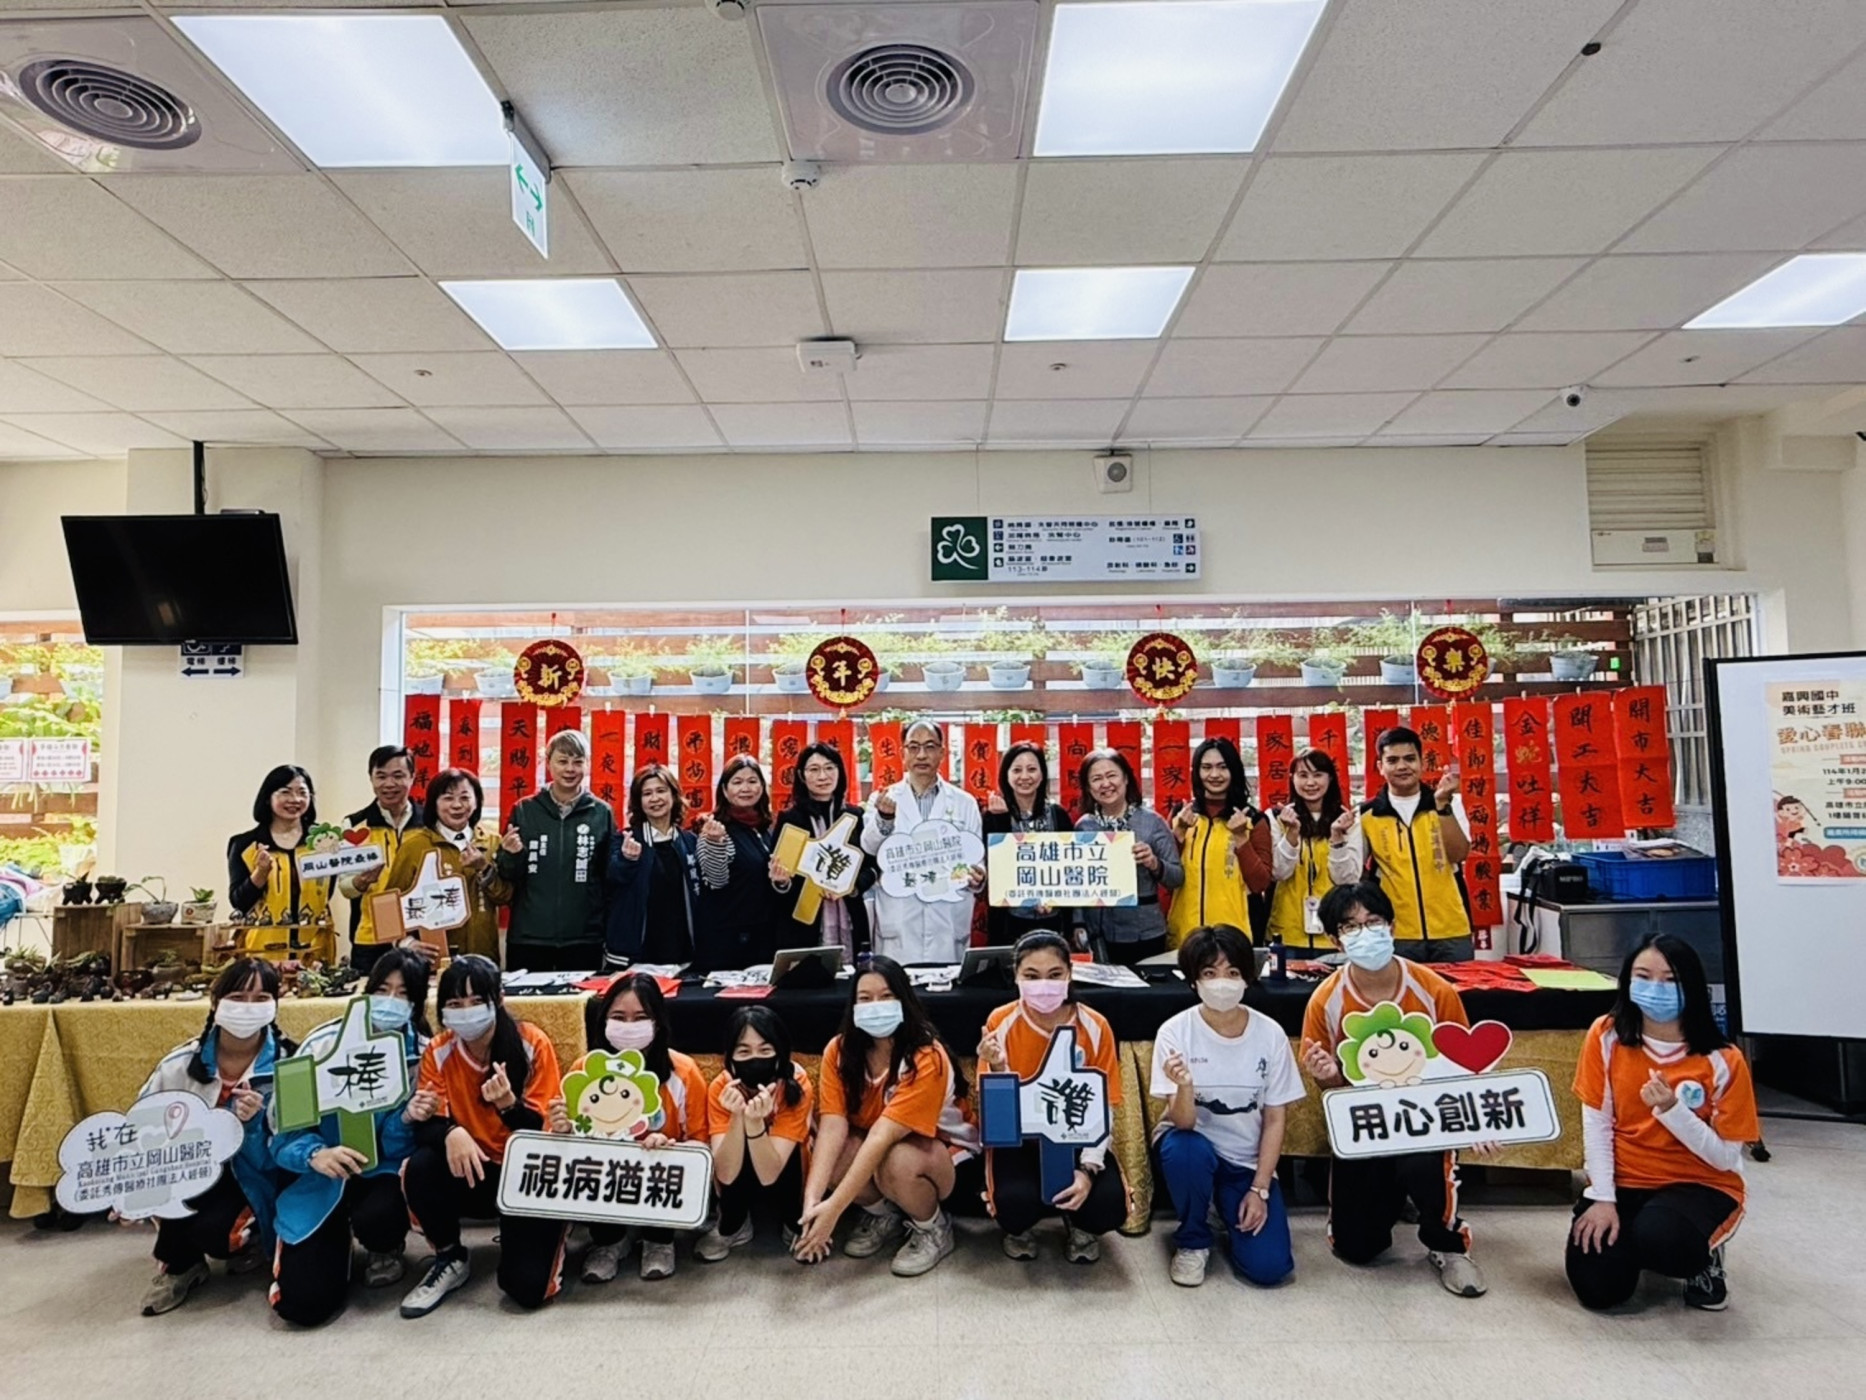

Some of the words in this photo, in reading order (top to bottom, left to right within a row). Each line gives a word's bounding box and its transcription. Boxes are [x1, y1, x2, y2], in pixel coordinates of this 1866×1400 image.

[538, 663, 563, 690] 新
[831, 660, 853, 687] 年
[1151, 656, 1176, 682] 快
[1511, 710, 1546, 831] 金蛇吐祥
[1570, 703, 1604, 829] 開工大吉
[1629, 697, 1658, 817] 開市大吉
[1016, 841, 1108, 862] 高雄市立
[1016, 865, 1109, 887] 岡山醫院
[327, 1045, 390, 1099] 棒
[1037, 1077, 1096, 1133] 讚
[1349, 1086, 1526, 1142] 用心創新
[77, 1140, 213, 1181] 高雄市立岡山醫院
[86, 1122, 139, 1152] 我在
[518, 1152, 684, 1209] 視病猶親
